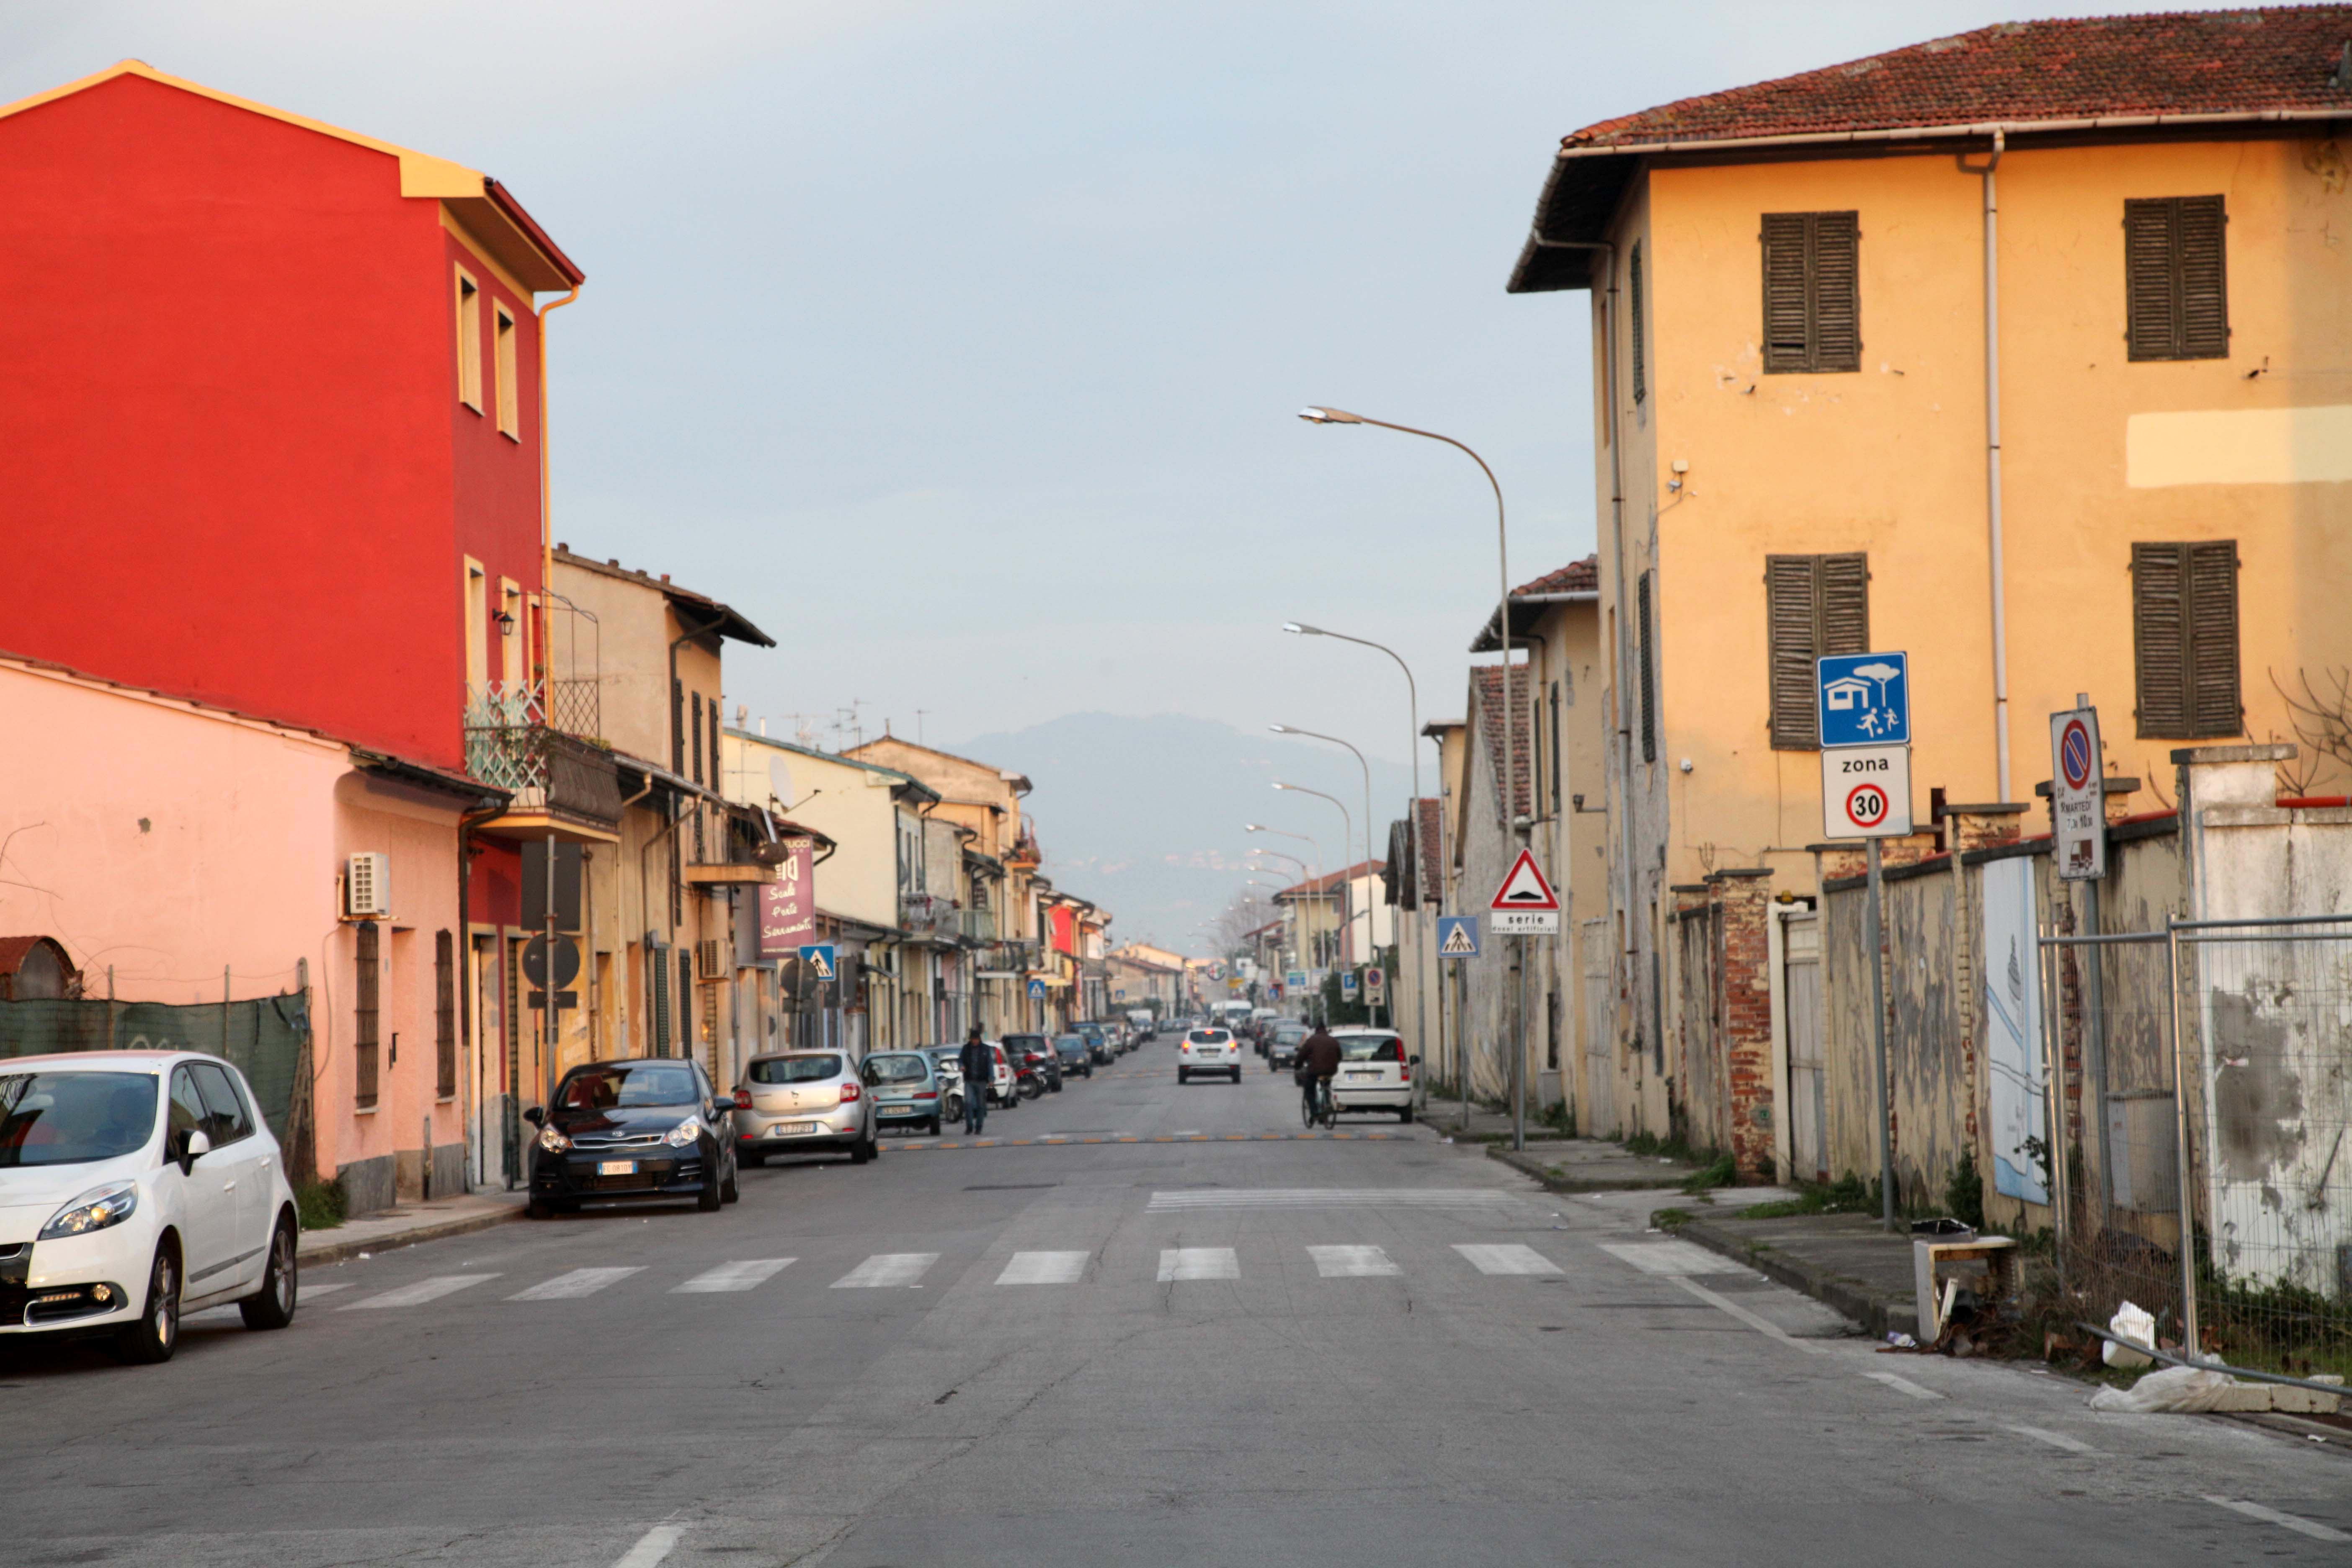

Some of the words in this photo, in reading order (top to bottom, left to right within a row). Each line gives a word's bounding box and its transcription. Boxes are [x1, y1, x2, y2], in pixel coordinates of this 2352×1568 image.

[1842, 758, 1889, 773] zona
[1855, 795, 1880, 816] 30
[761, 916, 812, 938] Serramenti
[1508, 914, 1544, 924] serie
